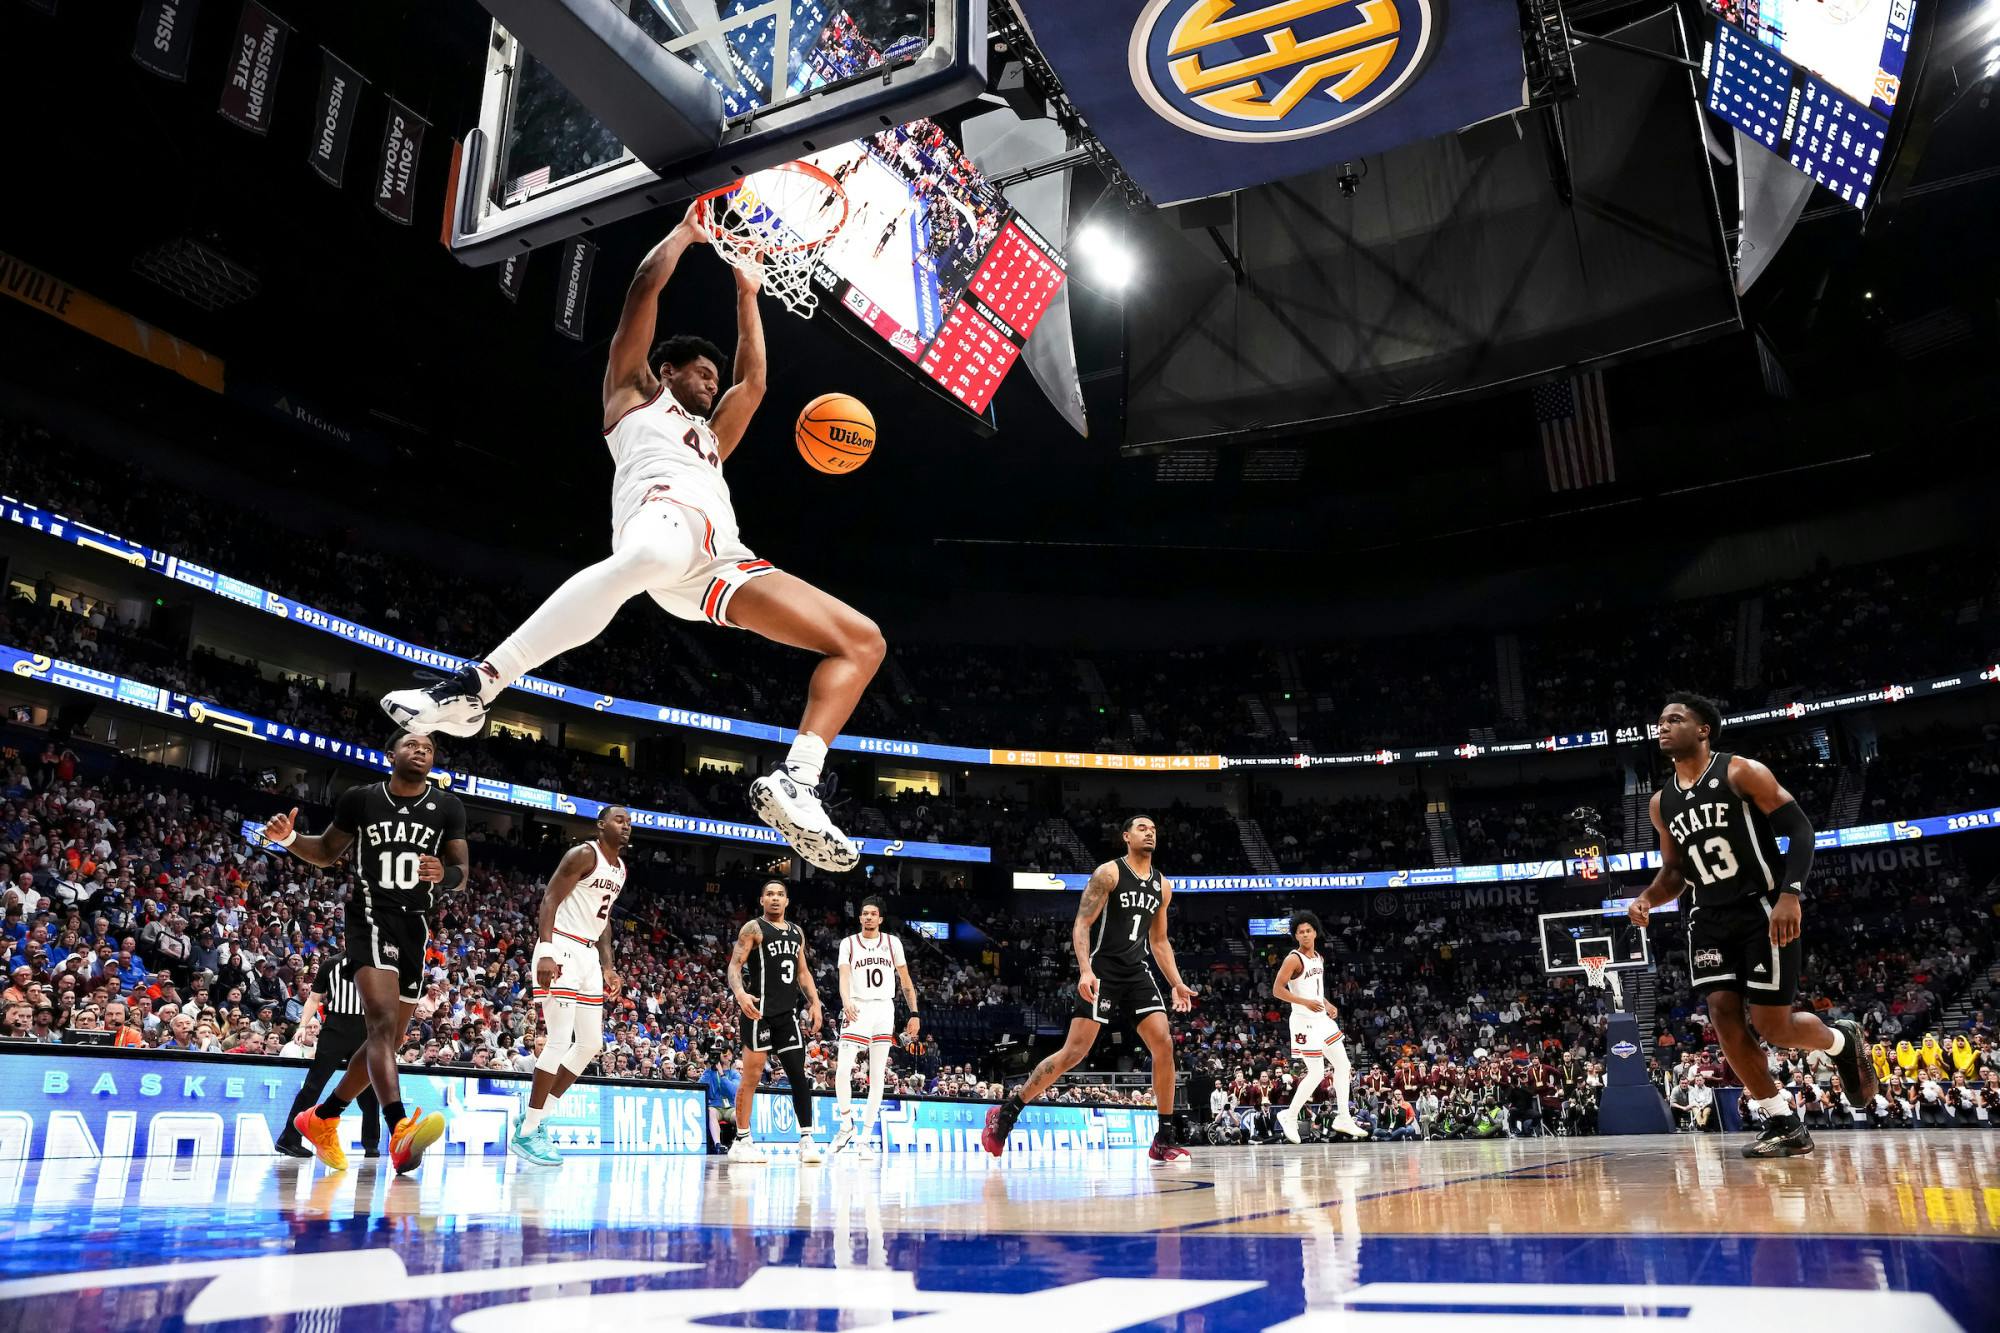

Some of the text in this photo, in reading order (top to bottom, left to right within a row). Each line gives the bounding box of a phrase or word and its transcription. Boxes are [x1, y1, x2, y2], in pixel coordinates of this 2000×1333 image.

[1894, 1, 1907, 21] 57
[153, 4, 177, 52] MISS
[232, 34, 257, 91] STATE
[245, 23, 278, 122] MISSISSIPPI
[1701, 41, 1713, 79] AUBURN
[318, 76, 346, 160] MISSOURI
[1782, 87, 1801, 140] TEAM STATS
[379, 115, 405, 199] CAROLINA
[396, 137, 414, 195] SOUTH
[1047, 249, 1067, 270] STATE
[563, 243, 586, 329] VANDERBILT
[851, 293, 865, 308] 56
[976, 301, 1013, 337] TEAM STATS
[829, 425, 873, 450] Wilson
[295, 607, 329, 628] 2024
[331, 620, 356, 638] SEC
[358, 630, 395, 651] MEN'S
[1904, 671, 1988, 695] 11 ASSISTS 6
[658, 708, 731, 731] #SECMBB
[1728, 716, 1744, 725] FREE
[1744, 712, 1770, 722] THROWS
[1590, 731, 1604, 741] 57
[1616, 726, 1638, 738] 4:41
[859, 739, 919, 755] #SECMBB
[1415, 750, 1439, 758] ASSISTS
[630, 812, 777, 842] SEC MEN'S BASKETBALL
[1669, 802, 1729, 845] STATE
[1947, 813, 1990, 830] 2024
[366, 821, 435, 849] STATE
[1574, 845, 1600, 858] 4:40
[1688, 836, 1740, 886] 13
[1851, 844, 1943, 875] MORE
[378, 851, 421, 890] 10
[1190, 875, 1366, 890] BASKETBALL TOURNAMENT
[596, 894, 611, 920] 2
[1119, 890, 1161, 915] STATE
[1465, 884, 1540, 909] MORE
[1129, 914, 1142, 941] 1
[780, 959, 795, 985] 3
[854, 956, 893, 970] AUBURN
[866, 968, 884, 989] 10
[613, 1095, 702, 1153] MEANS
[929, 1110, 974, 1122] MEN'S
